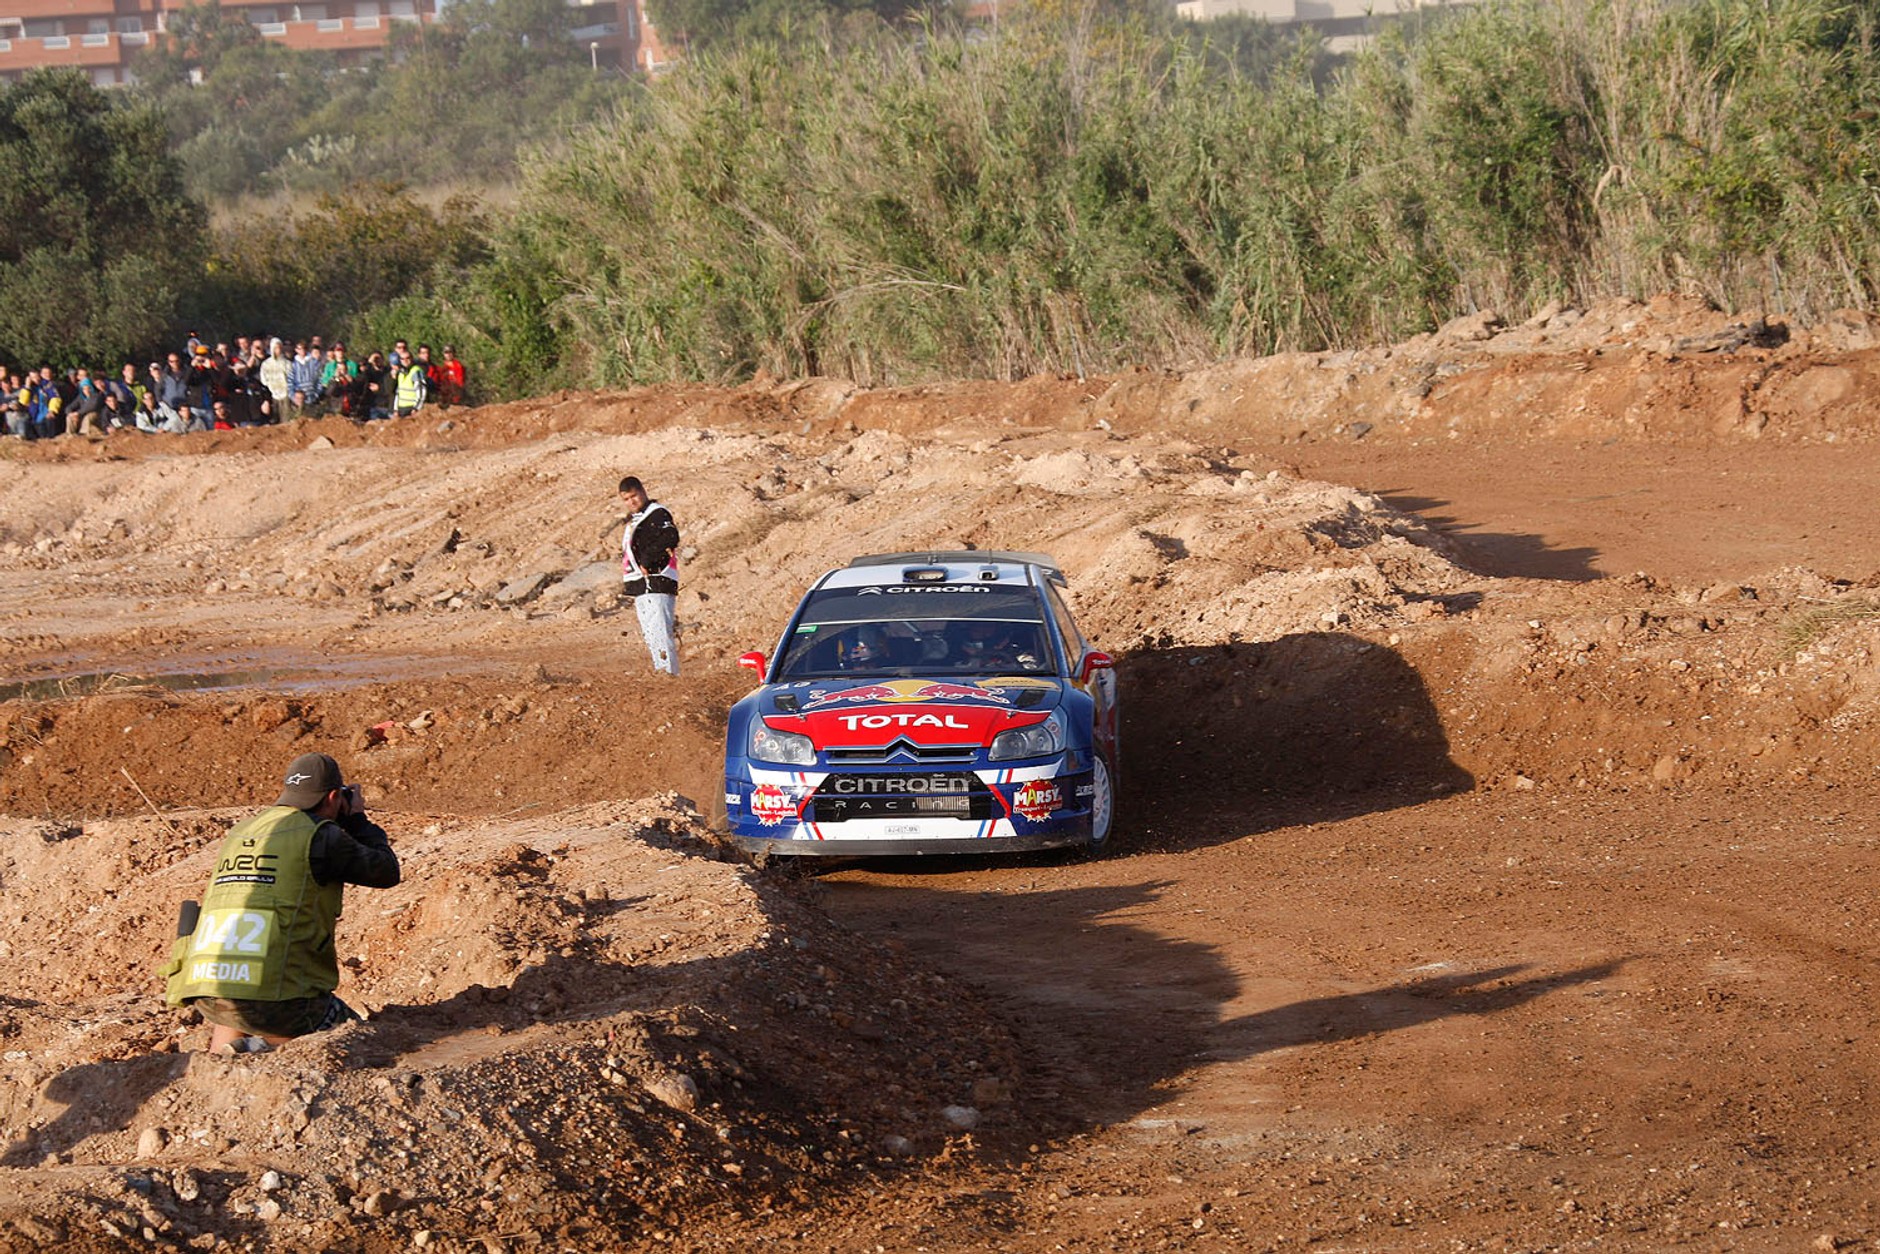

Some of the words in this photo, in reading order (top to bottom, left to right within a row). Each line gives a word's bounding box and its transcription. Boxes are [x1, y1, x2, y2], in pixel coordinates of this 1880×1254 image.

[838, 714, 969, 731] TOTAL
[750, 792, 791, 811] MARSY
[1013, 788, 1060, 806] MARSY
[218, 855, 278, 873] WRC
[195, 913, 266, 952] 042
[192, 962, 250, 981] MEDIA
